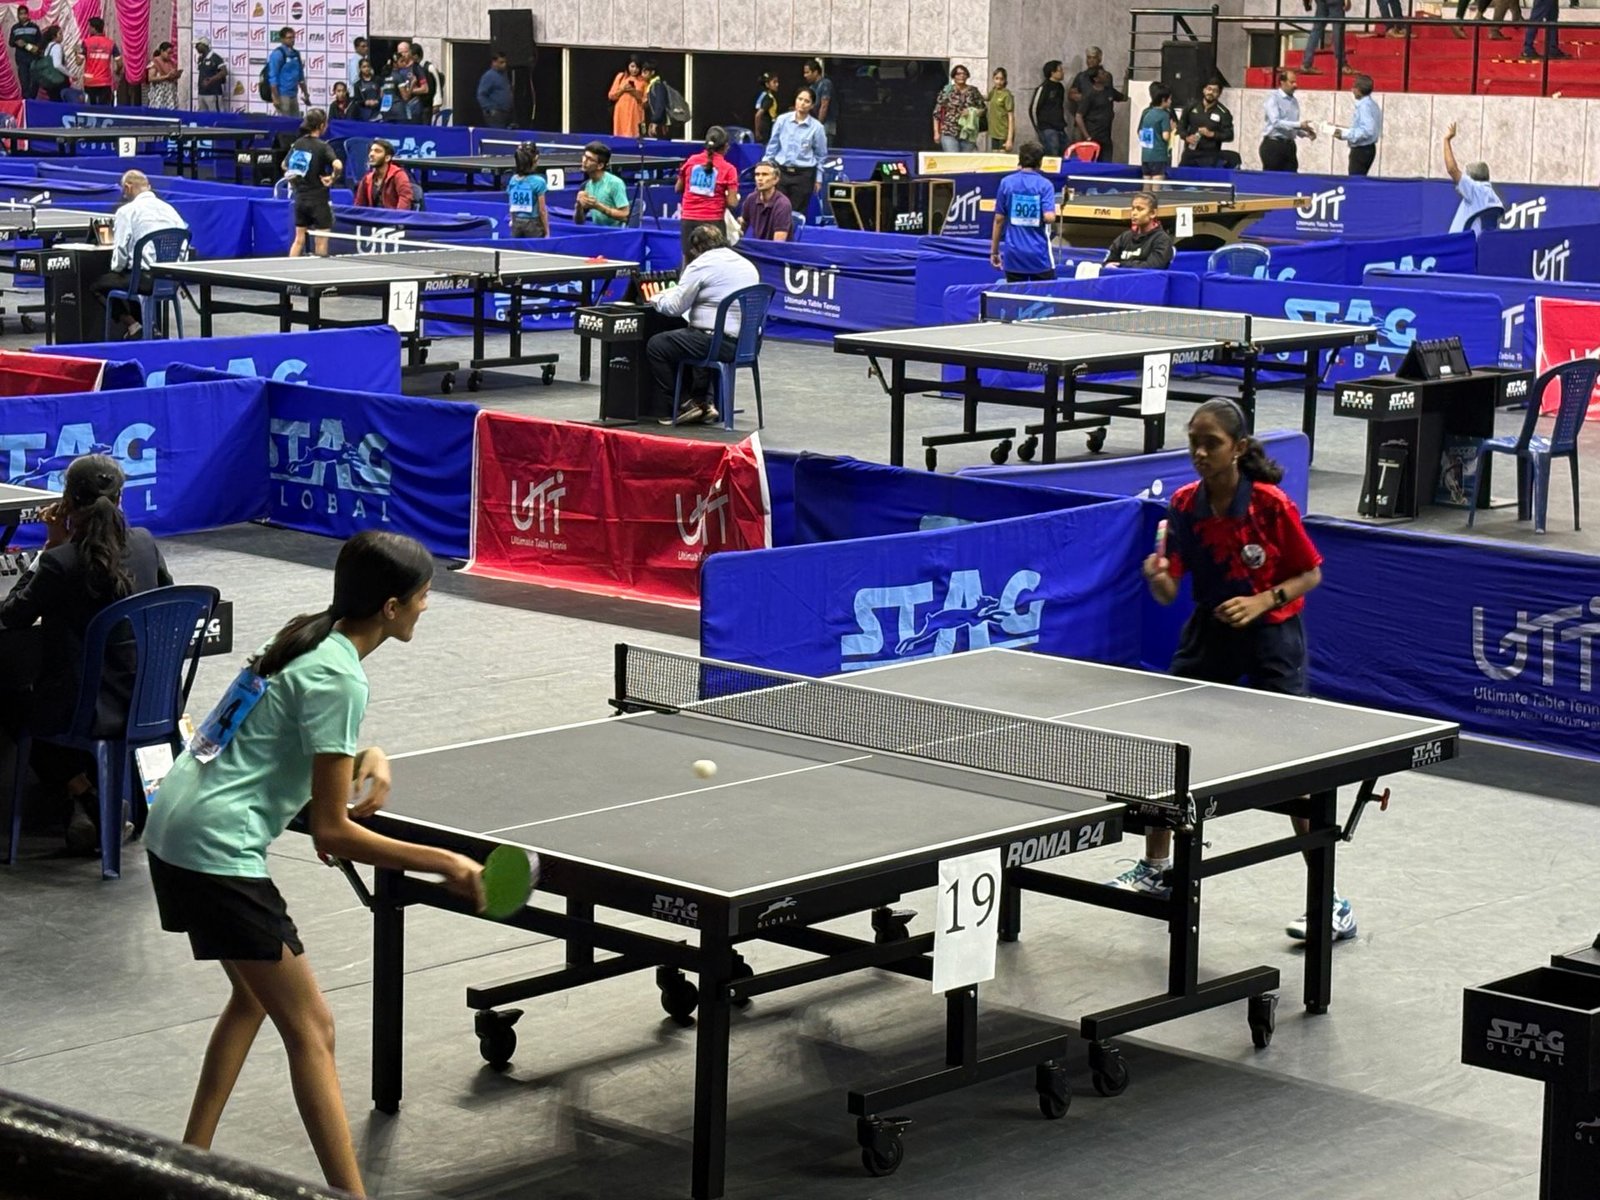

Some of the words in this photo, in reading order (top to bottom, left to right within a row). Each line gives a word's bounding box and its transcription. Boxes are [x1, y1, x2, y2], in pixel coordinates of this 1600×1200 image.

[124, 142, 130, 153] 3
[552, 174, 558, 186] 2
[512, 192, 529, 203] 984
[895, 211, 923, 224] STAG
[1015, 203, 1037, 217] 902
[1181, 213, 1187, 227] 1
[424, 280, 455, 292] ROMA
[454, 278, 470, 290] 24
[393, 290, 415, 311] 14
[1172, 352, 1200, 365] ROMA
[1201, 349, 1215, 361] 24
[1147, 364, 1168, 390] 13
[1342, 390, 1373, 403] STAG
[1389, 391, 1415, 404] STAG
[280, 485, 391, 522] LOBAL
[511, 470, 567, 534] UTT
[511, 535, 535, 548] Ultimate
[534, 537, 549, 549] Table
[549, 539, 567, 550] Tennis
[841, 569, 1046, 672] STAG
[1474, 686, 1529, 705] Ultimate
[1532, 692, 1566, 709] Table
[1569, 698, 1600, 715] Tenn
[1412, 741, 1442, 761] STAG
[1006, 829, 1071, 868] ROMA
[1076, 821, 1106, 850] 24
[652, 894, 698, 921] STAG
[945, 872, 997, 935] 19
[652, 911, 698, 928] GLOBAL
[757, 913, 798, 929] GLOBAL
[1486, 1017, 1565, 1056] STAG
[1486, 1041, 1565, 1066] GLOBAL
